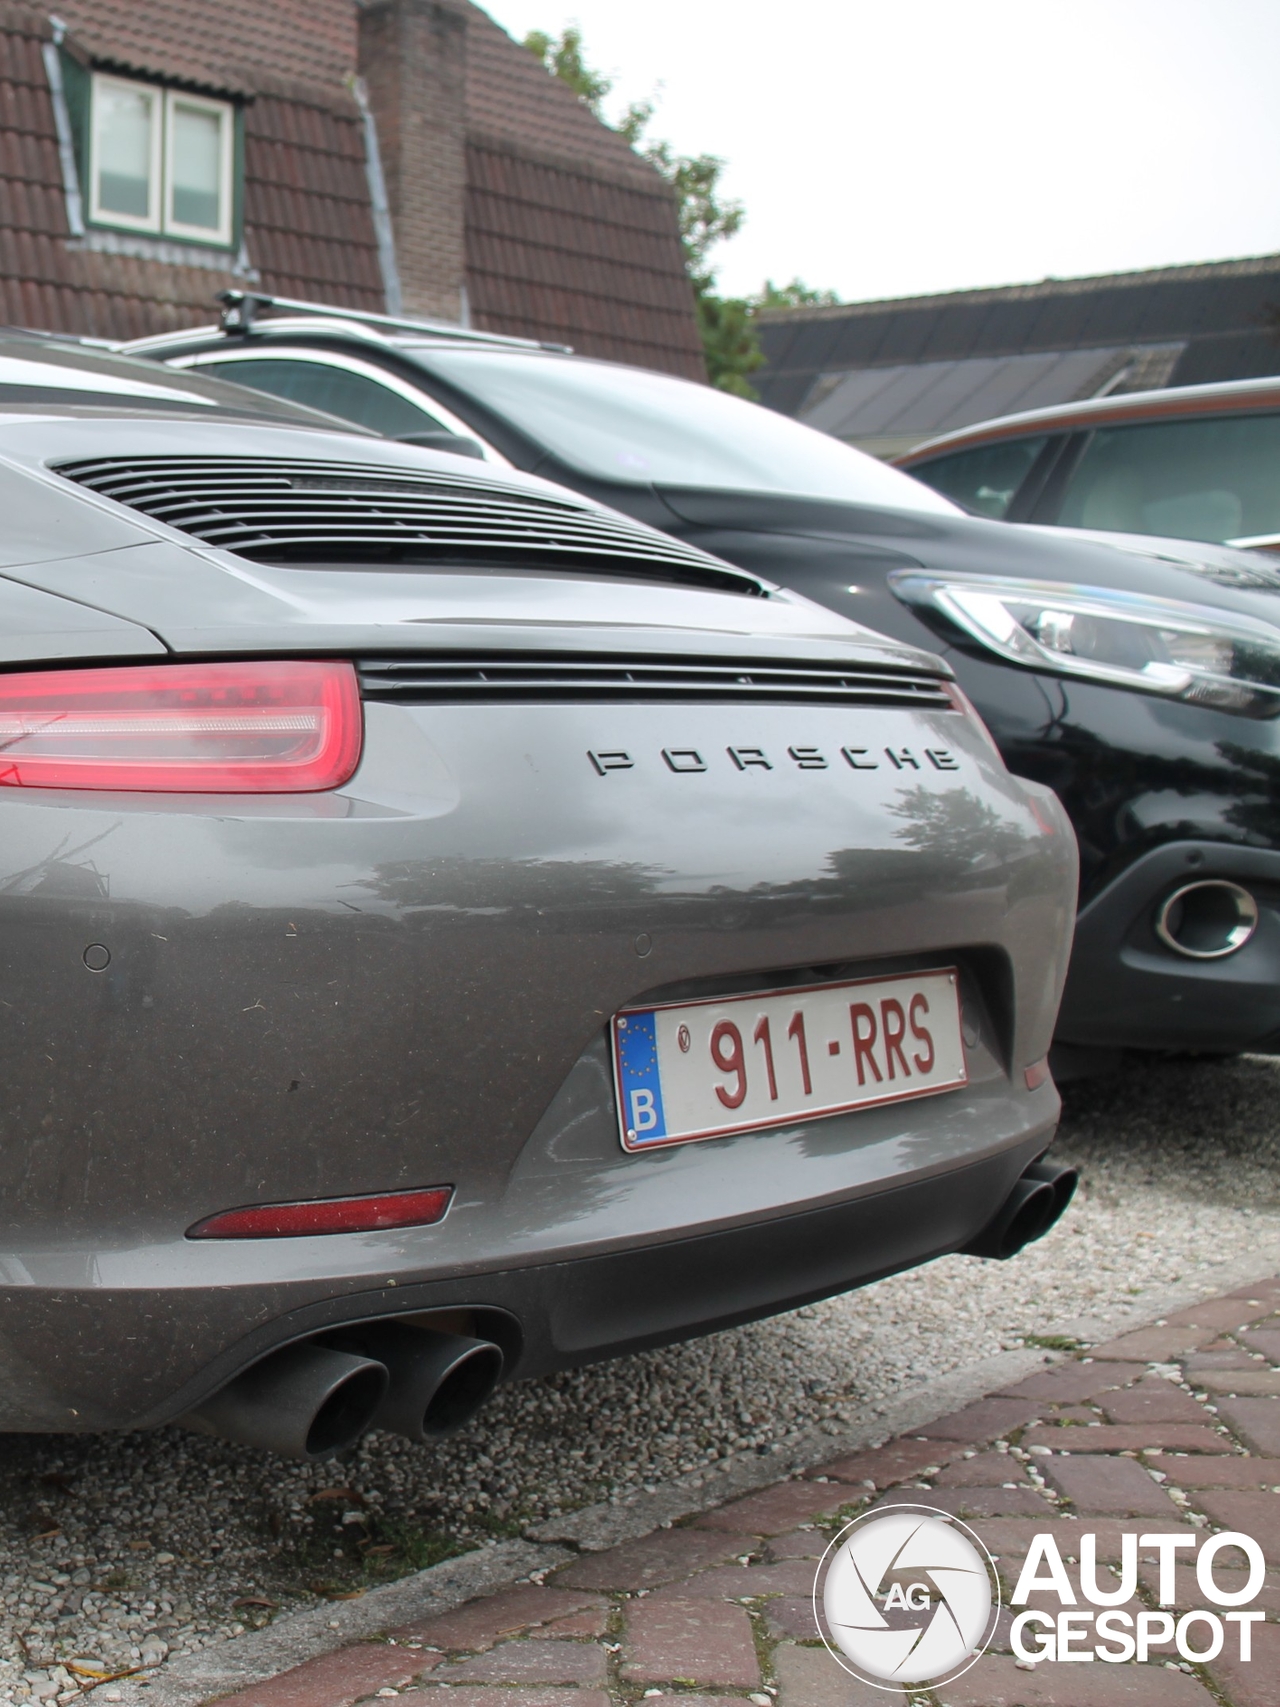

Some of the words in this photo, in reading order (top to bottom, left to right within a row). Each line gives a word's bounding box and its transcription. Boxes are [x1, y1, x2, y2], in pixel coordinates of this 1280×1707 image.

[586, 745, 960, 776] PORSCHE
[709, 992, 936, 1110] 911-RRS
[629, 1088, 658, 1132] B
